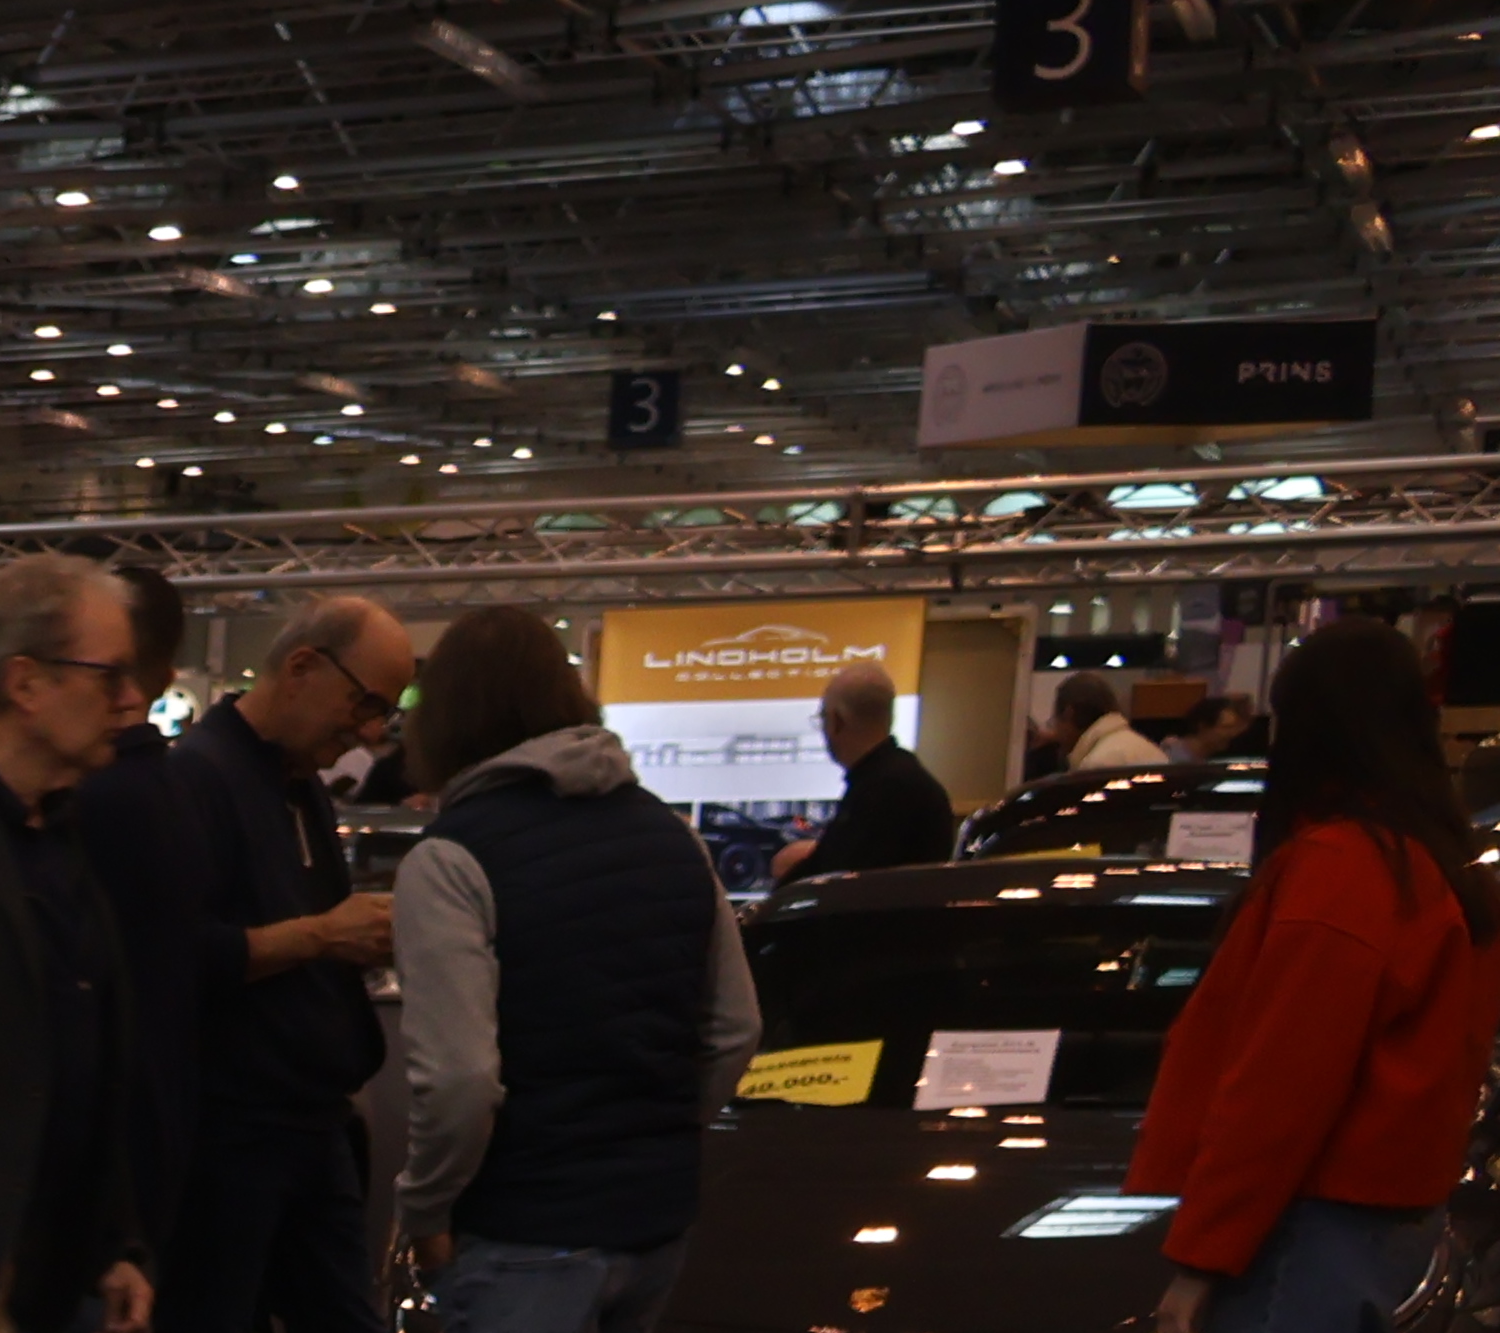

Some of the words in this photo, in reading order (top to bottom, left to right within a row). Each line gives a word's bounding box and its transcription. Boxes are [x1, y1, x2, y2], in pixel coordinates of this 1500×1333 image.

[1237, 360, 1334, 385] PRINS
[627, 377, 660, 433] 3
[642, 643, 887, 670] LINDHOLM
